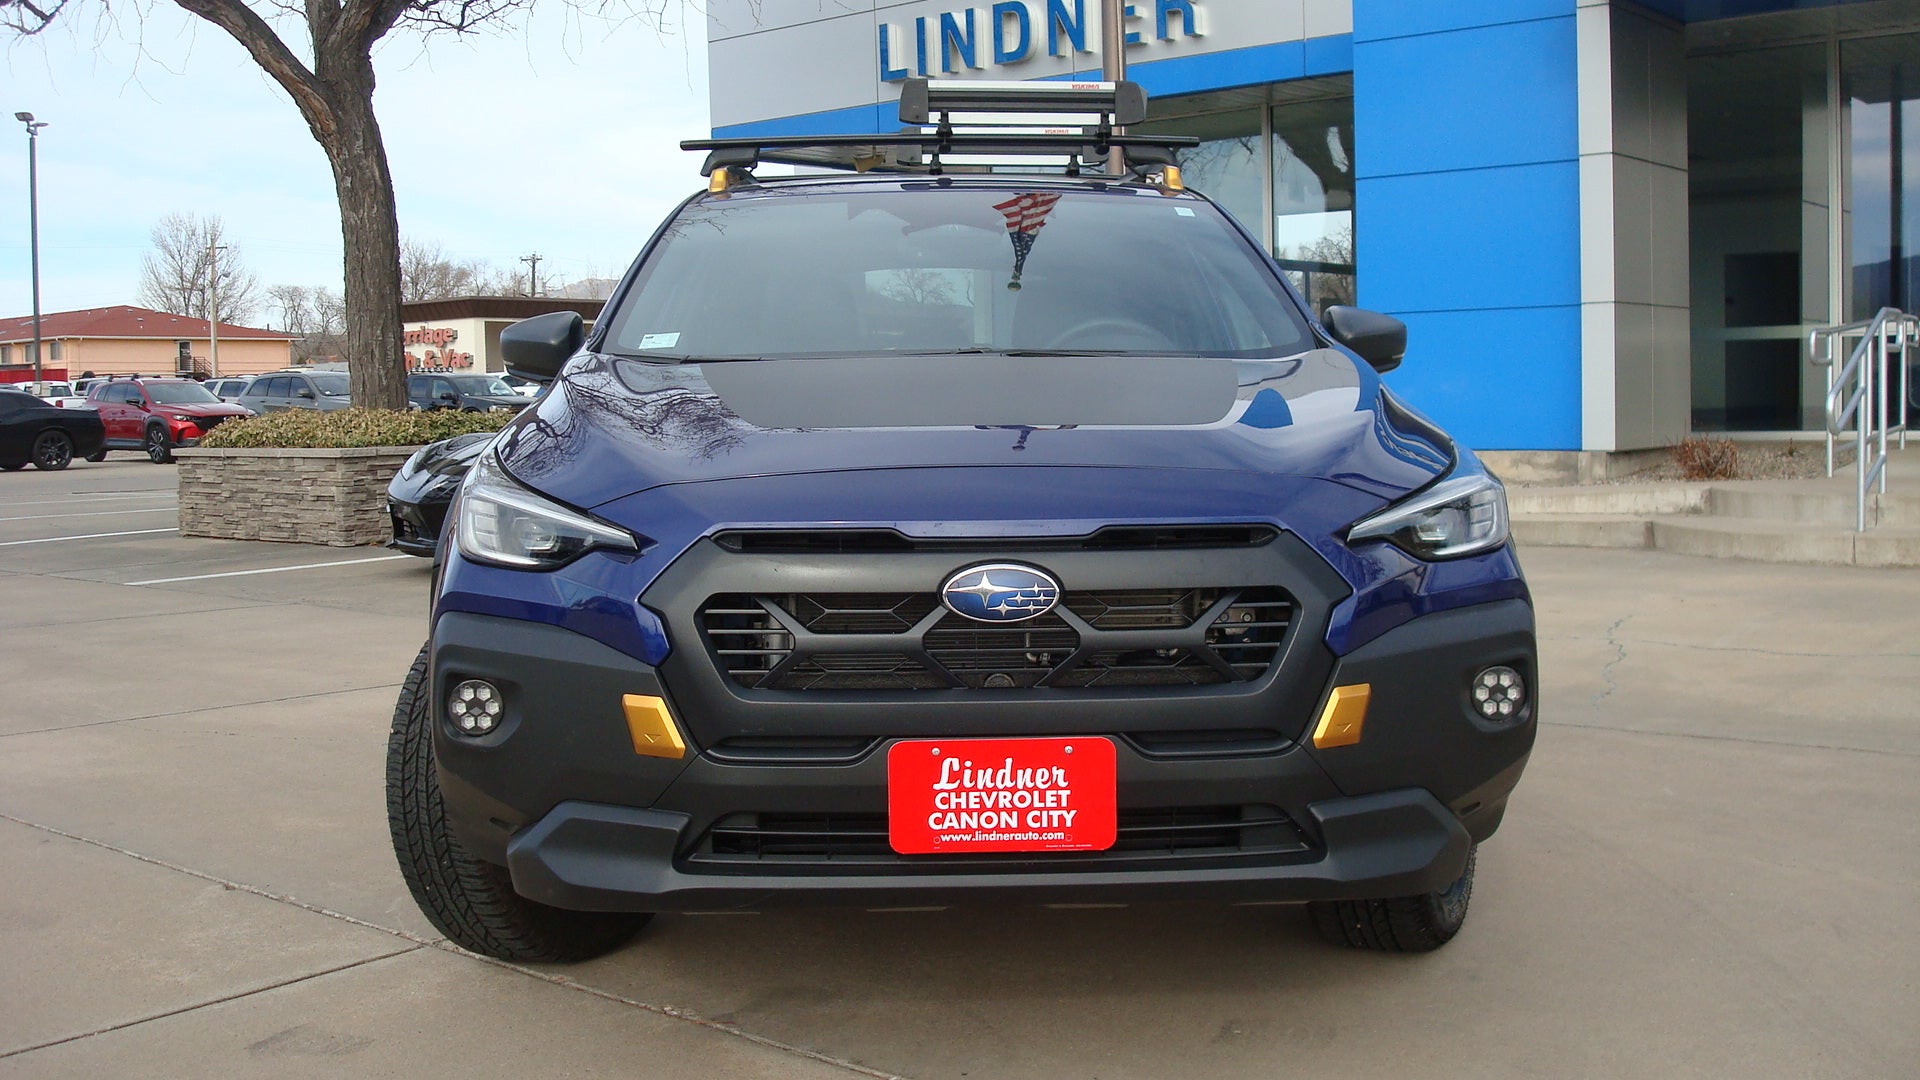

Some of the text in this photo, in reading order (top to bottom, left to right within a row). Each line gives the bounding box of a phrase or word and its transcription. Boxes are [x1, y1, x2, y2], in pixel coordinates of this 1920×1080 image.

[403, 325, 456, 348] rriage
[440, 349, 470, 368] Vac
[932, 757, 1069, 790] Lindner
[934, 789, 1071, 810] CHEVROLET
[928, 809, 1077, 830] CANON CITY
[940, 830, 1065, 842] www.lindnerauto.com
